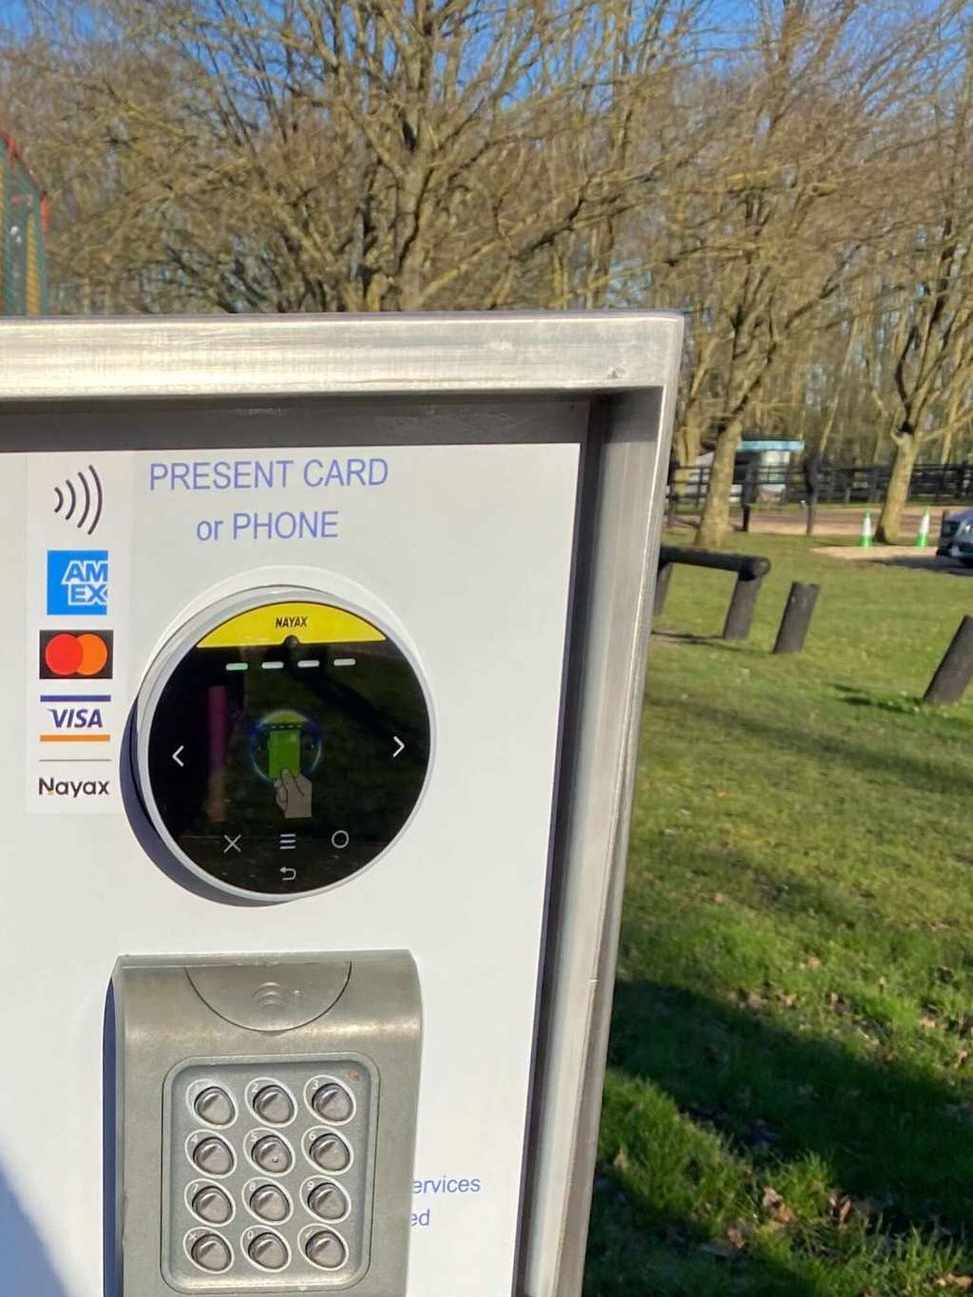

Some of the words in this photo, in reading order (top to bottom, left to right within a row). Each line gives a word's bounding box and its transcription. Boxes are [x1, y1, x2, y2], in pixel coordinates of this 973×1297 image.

[149, 460, 294, 491] PRESENT
[303, 458, 389, 488] CARD
[196, 519, 224, 541] or
[233, 511, 339, 540] PHONE
[275, 616, 308, 628] NAYAX
[47, 708, 103, 729] VISA
[38, 777, 110, 799] Nayax
